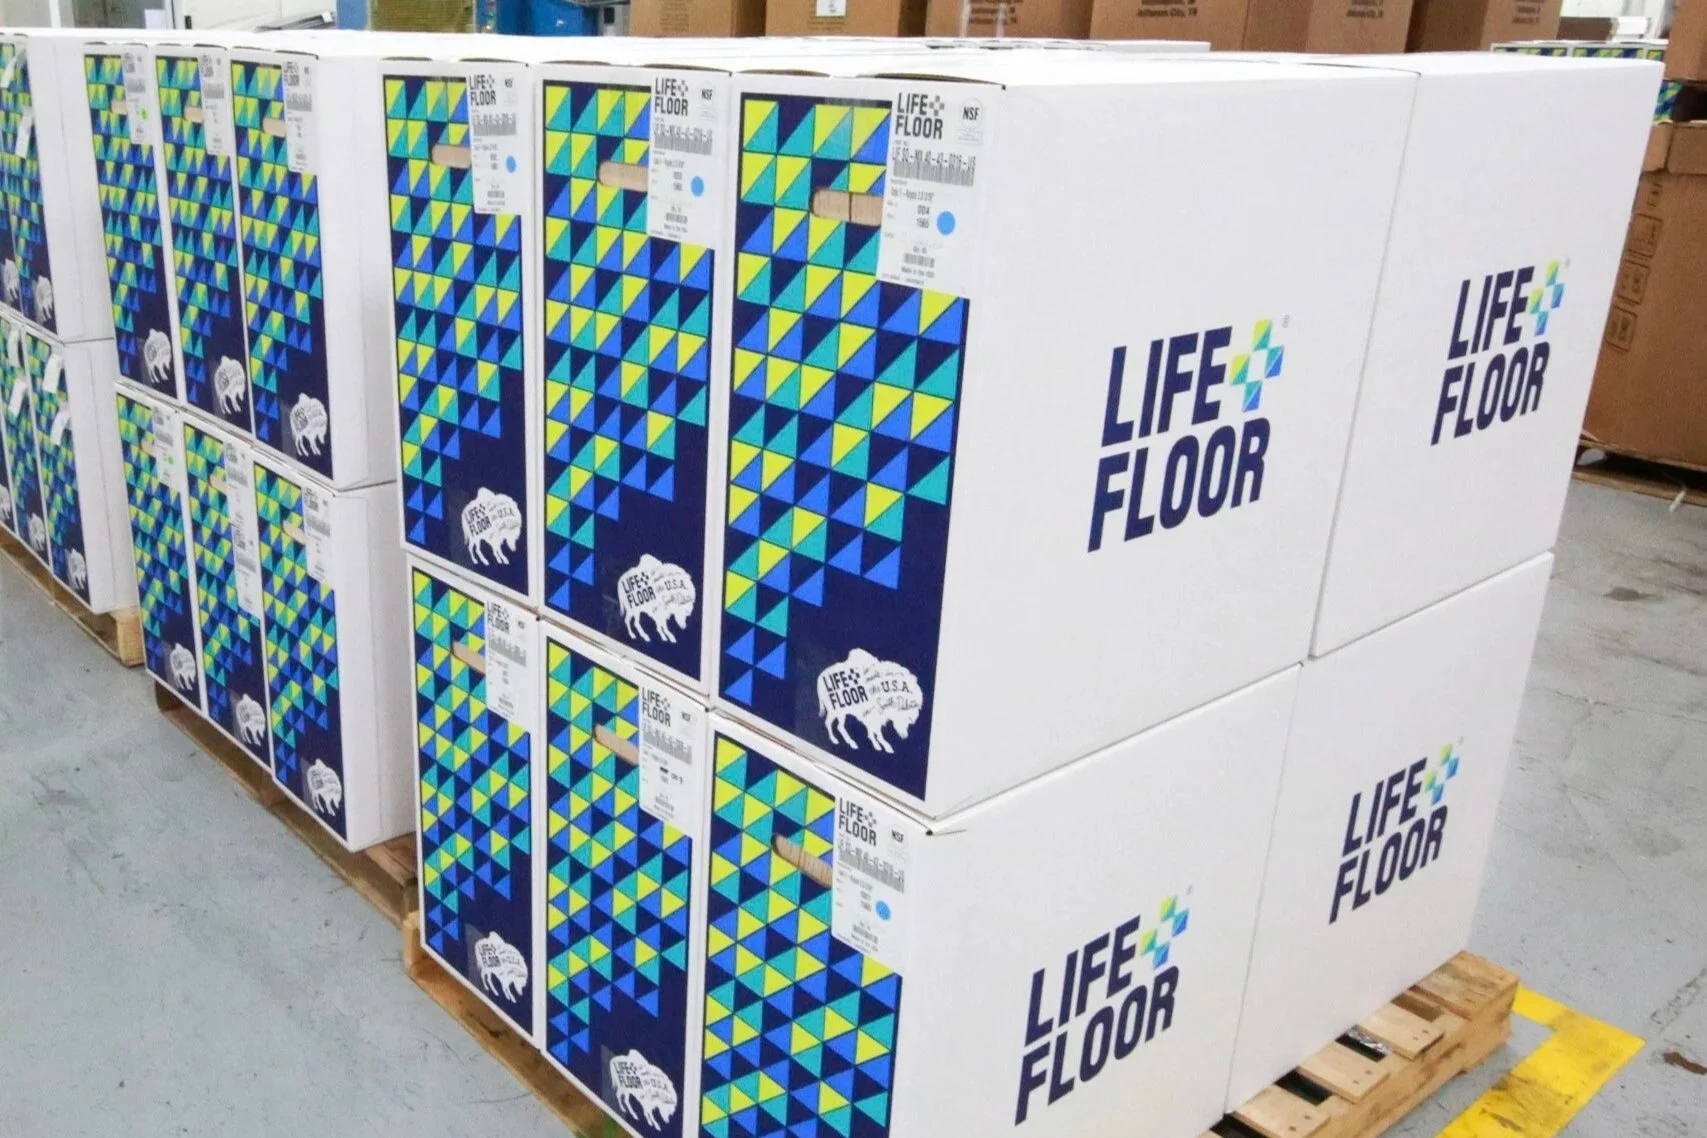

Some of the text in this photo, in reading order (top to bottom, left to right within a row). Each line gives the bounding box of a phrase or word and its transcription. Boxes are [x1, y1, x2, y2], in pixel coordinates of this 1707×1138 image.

[469, 74, 485, 90] LIFE
[655, 77, 677, 97] LIFE
[470, 90, 496, 106] FLOOR
[654, 96, 688, 116] FLOOR
[897, 92, 928, 116] LIFE
[963, 106, 979, 121] NSF
[895, 115, 943, 140] FLOOR
[1448, 265, 1535, 360] LIFE
[1101, 326, 1232, 447] LIFE
[1431, 341, 1550, 446] FLOOR
[1087, 417, 1270, 553] FLOOR
[469, 516, 492, 536] FLOOR
[622, 574, 641, 593] LIFE
[627, 586, 656, 609] FLOOR
[823, 671, 849, 693] LIFE
[642, 687, 660, 708] LIFE
[829, 685, 868, 710] FLOOR
[642, 701, 671, 727] FLOOR
[839, 797, 863, 823] LIFE
[1342, 757, 1427, 857] LIFE
[838, 814, 877, 846] FLOOR
[1329, 805, 1448, 925] FLOOR
[1025, 914, 1141, 1047] LIFE
[1015, 966, 1179, 1126] FLOOR
[618, 1075, 643, 1090] FLOOR
